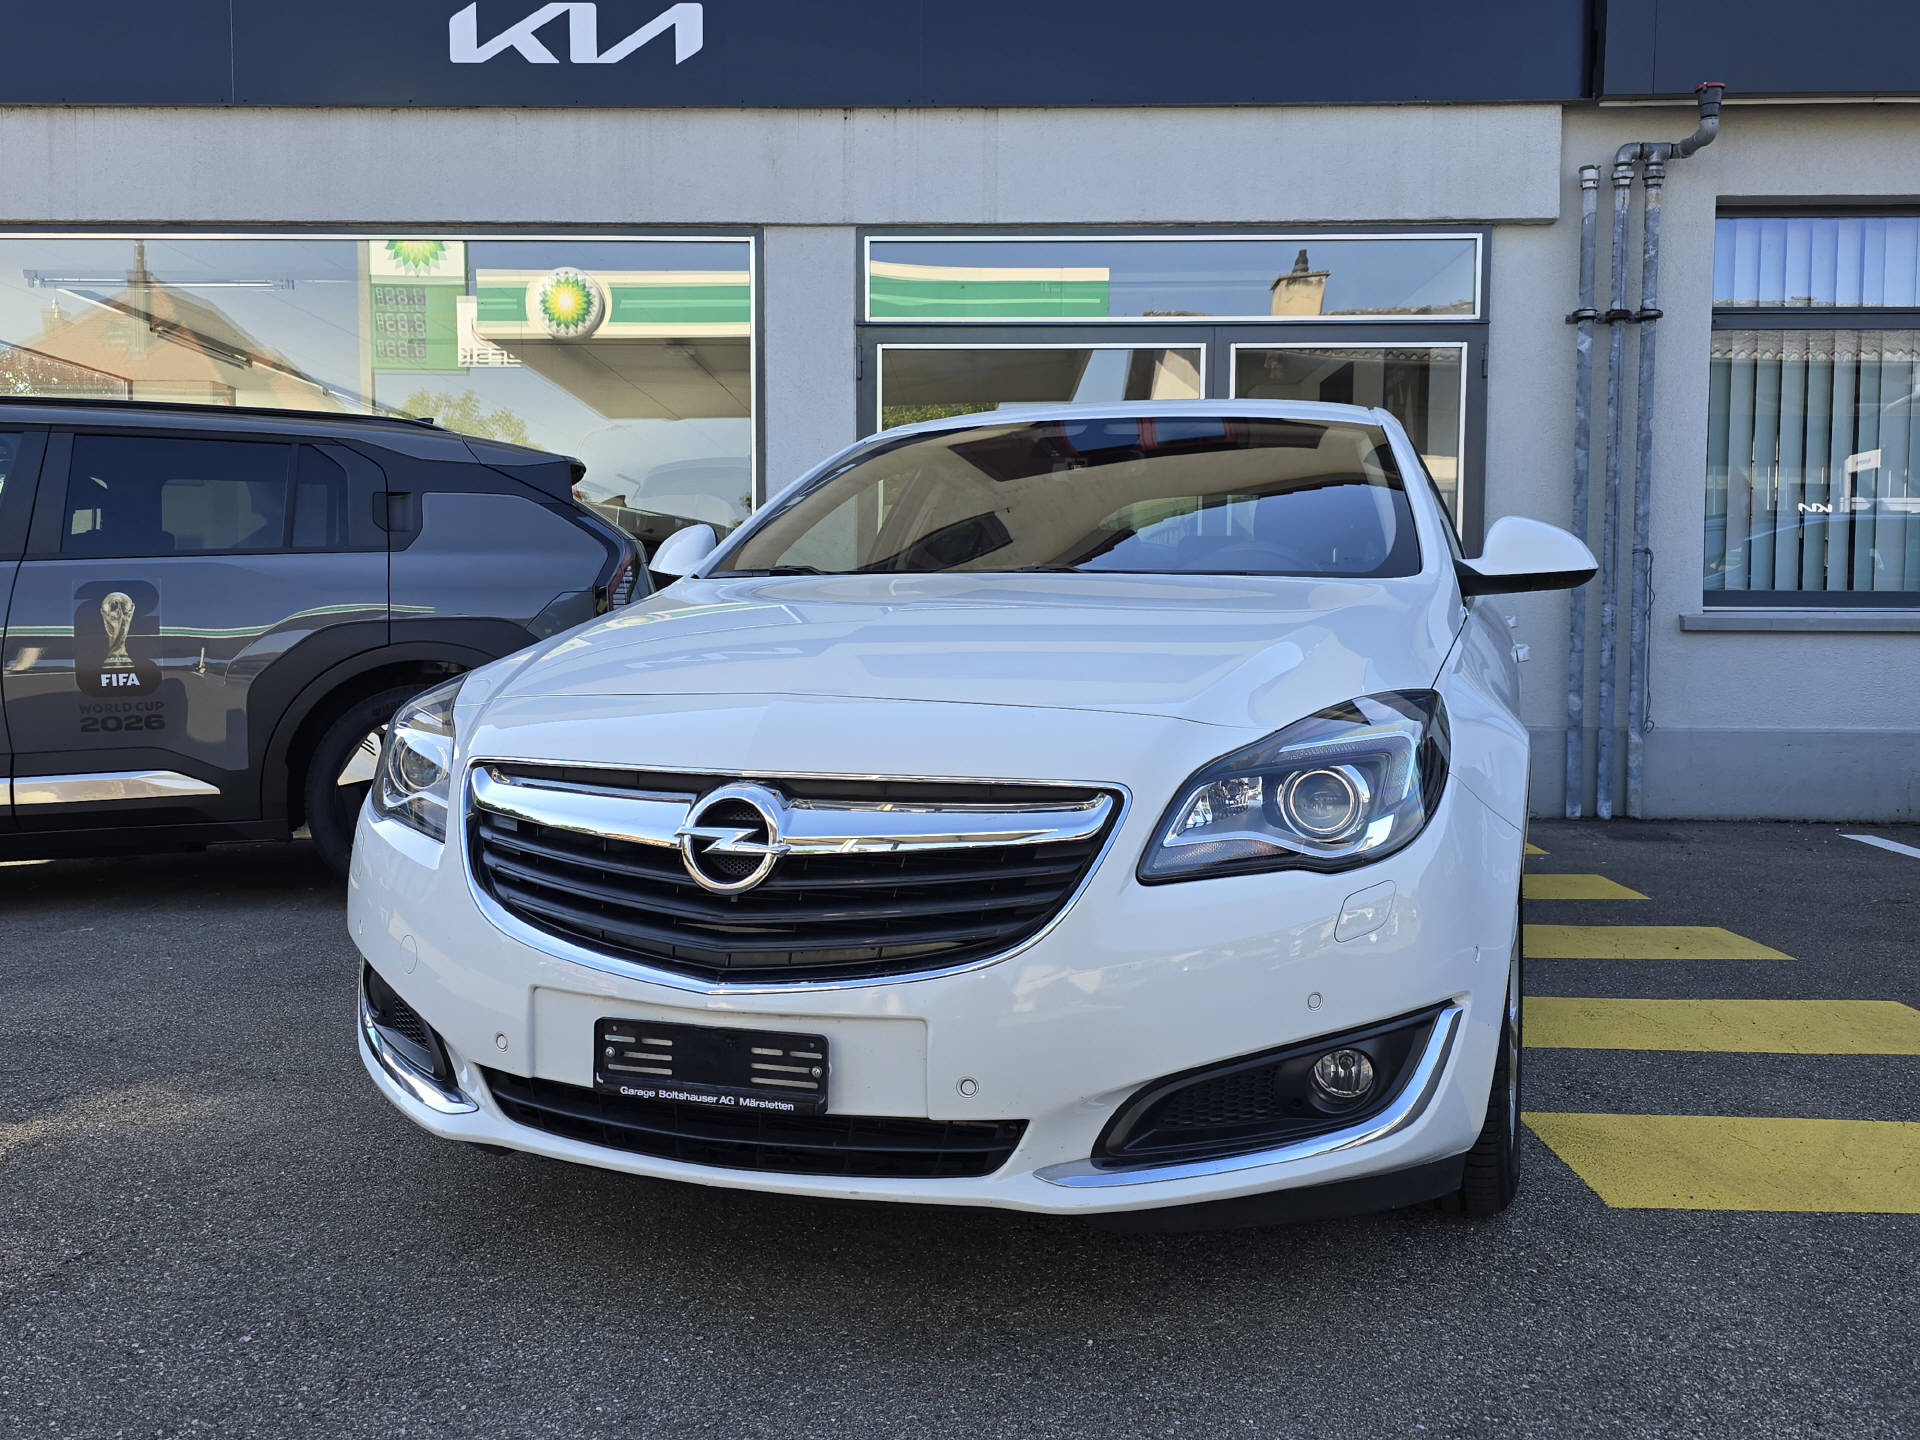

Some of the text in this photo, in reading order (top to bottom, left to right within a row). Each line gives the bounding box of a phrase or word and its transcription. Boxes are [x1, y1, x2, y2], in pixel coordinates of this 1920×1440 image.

[449, 2, 703, 64] KIA
[100, 672, 141, 687] FIFA
[79, 701, 164, 714] WORLD CUP
[80, 714, 166, 732] 2026
[619, 1086, 795, 1112] Garage Boltshauser AG Märstetten
